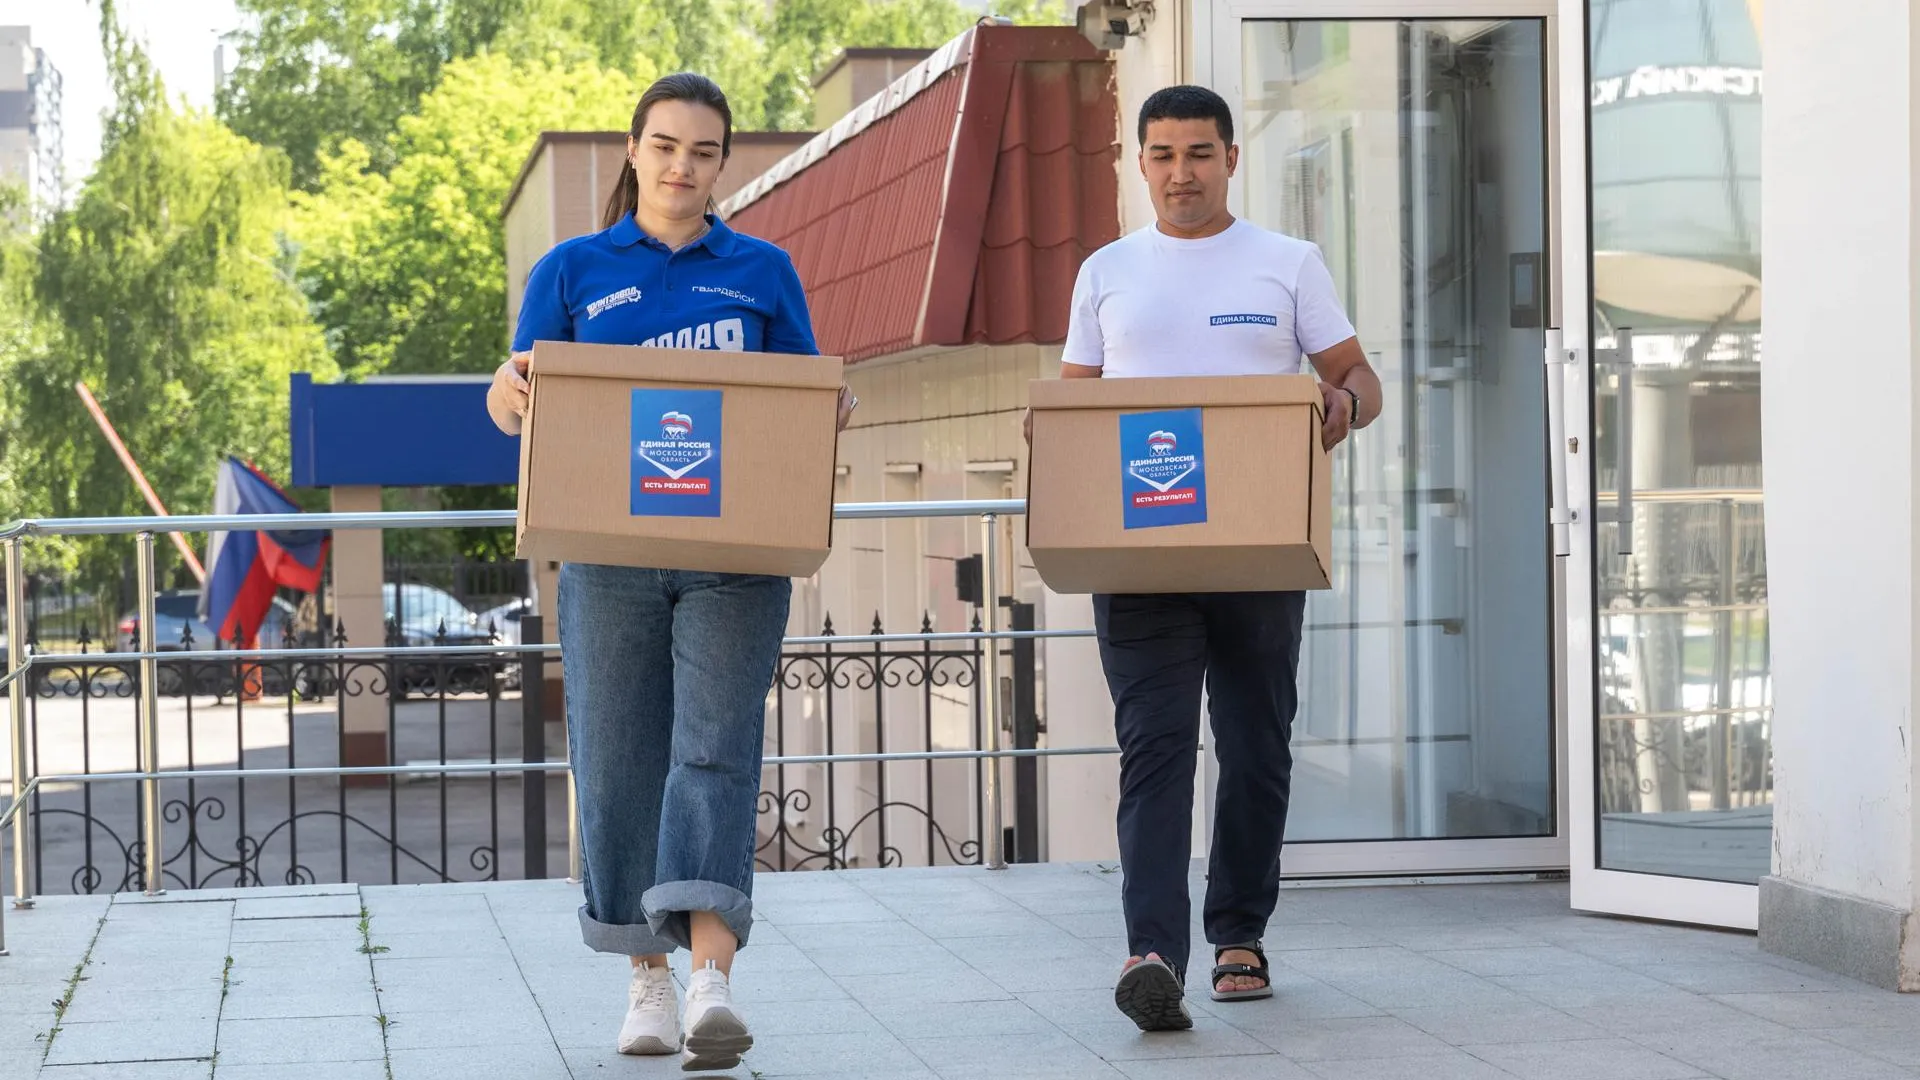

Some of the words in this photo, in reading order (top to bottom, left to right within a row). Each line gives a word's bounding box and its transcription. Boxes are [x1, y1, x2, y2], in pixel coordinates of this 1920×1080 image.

[691, 285, 756, 304] ГВАРДЕЙСК
[1212, 316, 1245, 325] ЕДИНАЯ
[1246, 315, 1276, 325] РОССИЯ
[640, 440, 676, 449] ЕДИНАЯ
[677, 441, 711, 449] РОССИЯ
[1130, 458, 1162, 467] ЕДИНАЯ
[1164, 454, 1195, 463] РОССИЯ
[1138, 463, 1187, 474] МОСКОВСКАЯ
